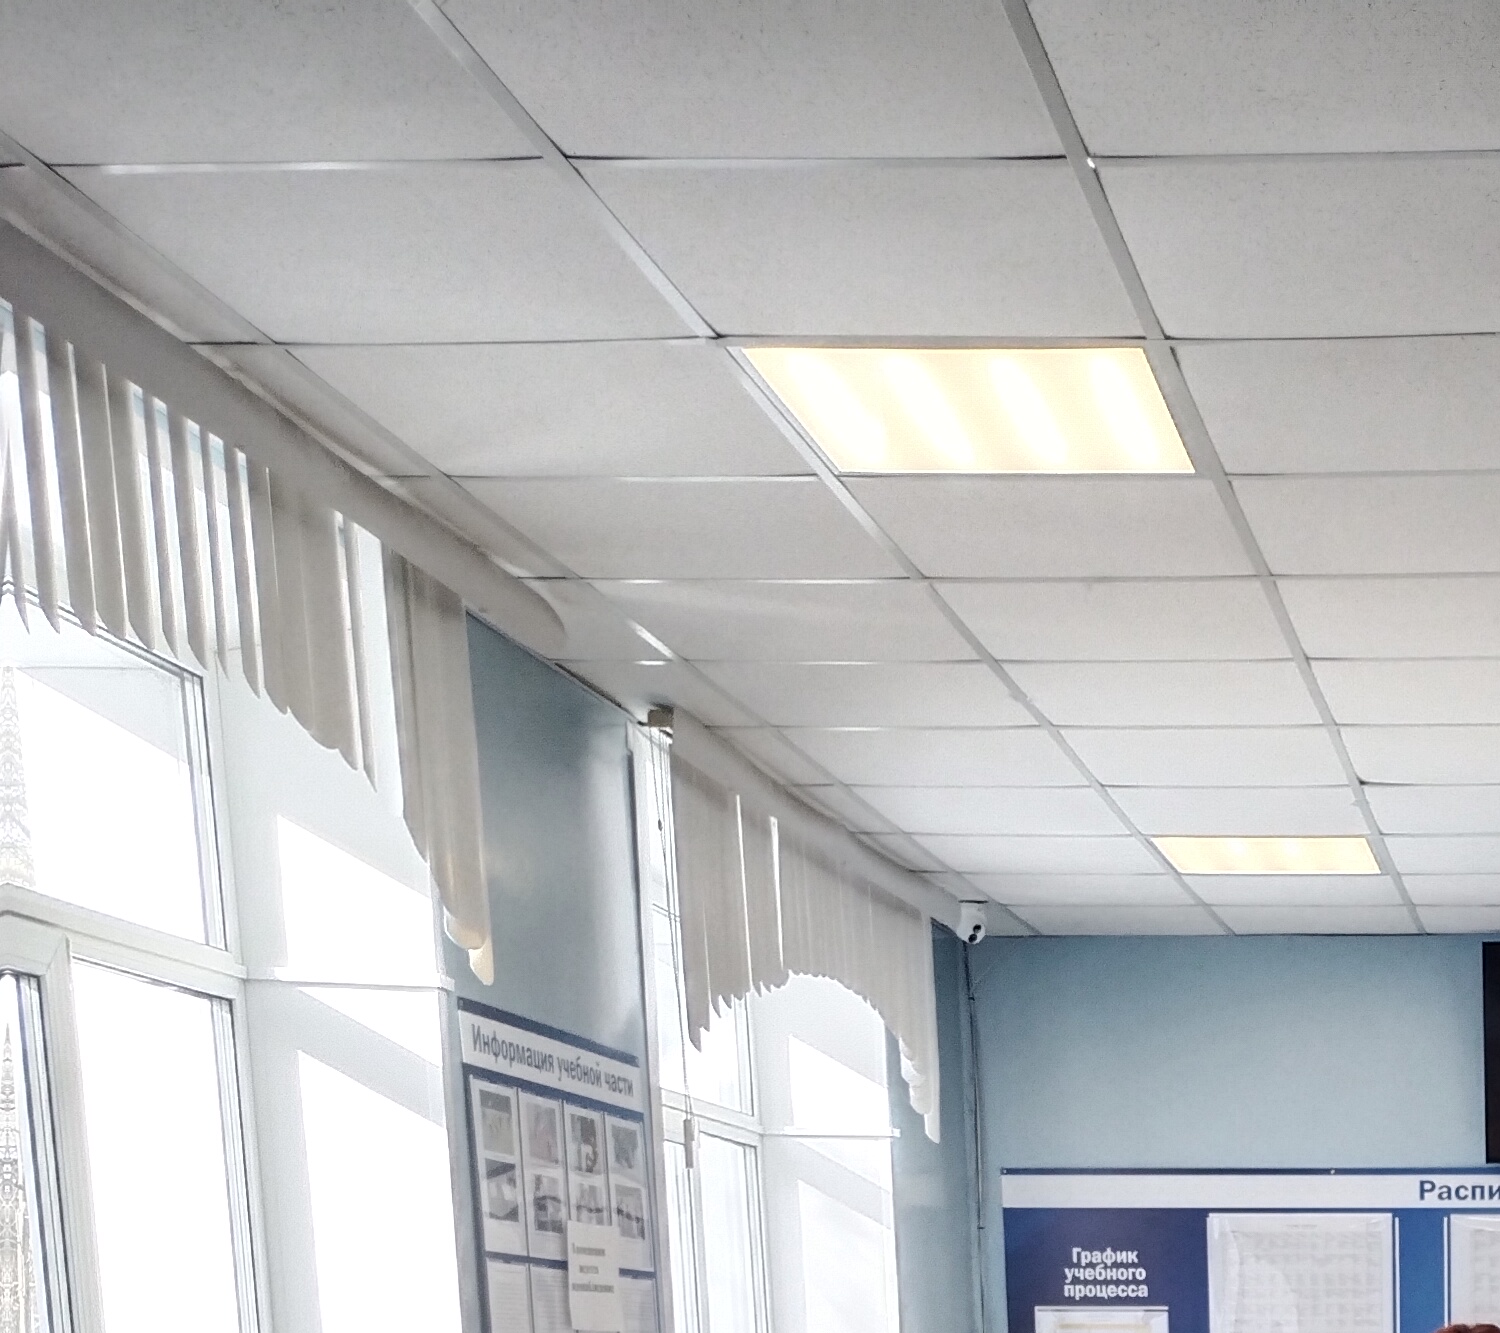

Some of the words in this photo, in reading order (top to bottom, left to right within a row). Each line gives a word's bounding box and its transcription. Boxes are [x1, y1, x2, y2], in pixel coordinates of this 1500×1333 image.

[472, 1024, 555, 1074] Информация
[557, 1056, 603, 1088] учебной
[605, 1076, 634, 1097] части
[1072, 1247, 1139, 1266] График
[1064, 1265, 1147, 1283] учебного
[1064, 1284, 1149, 1300] процесса
